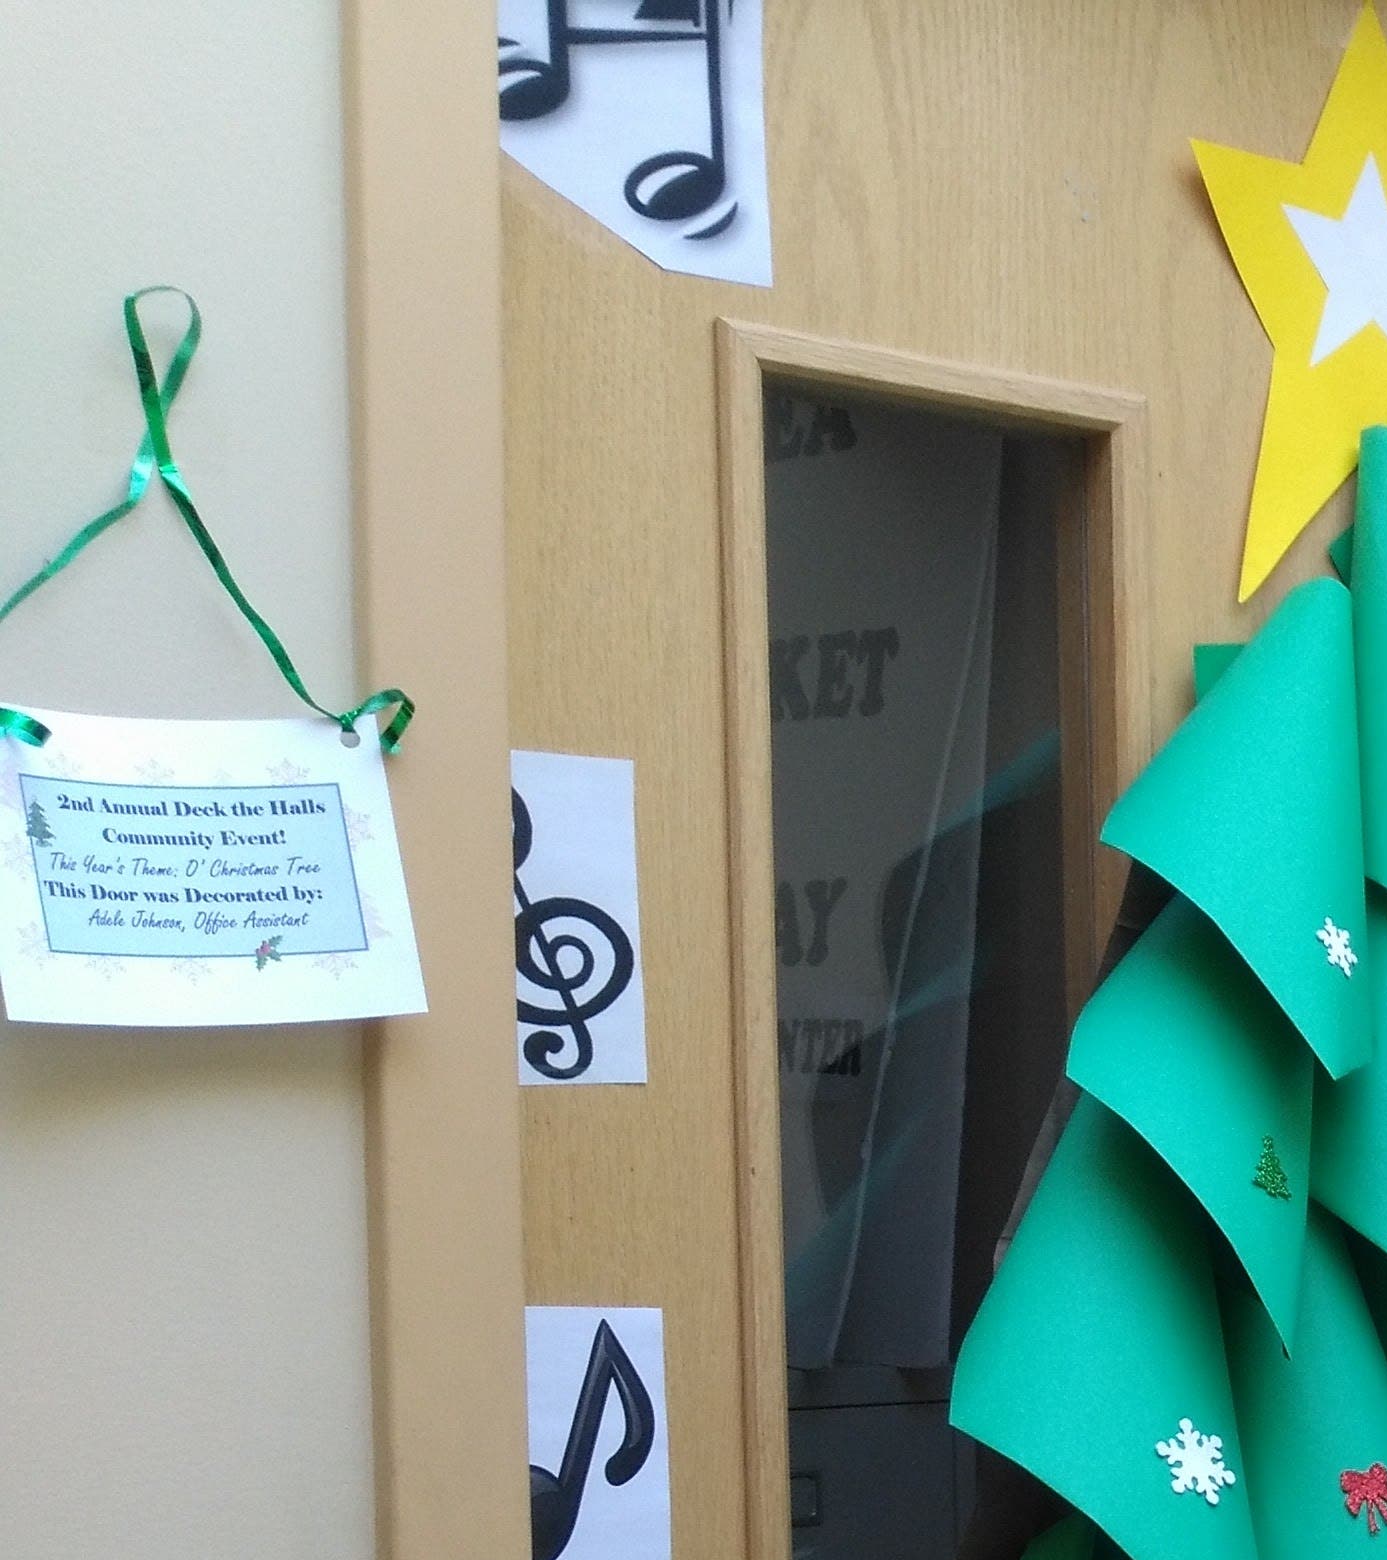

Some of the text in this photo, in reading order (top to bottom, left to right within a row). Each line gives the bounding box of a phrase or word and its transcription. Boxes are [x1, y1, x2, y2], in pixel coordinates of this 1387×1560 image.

[57, 793, 326, 817] 2nd Annual Deck the Halls
[102, 827, 287, 850] Community Event!
[50, 851, 77, 871] This
[83, 854, 126, 875] Year's
[132, 857, 178, 878] Theme:
[209, 858, 279, 877] Christmas
[287, 856, 321, 876] Tree
[43, 880, 323, 905] This Door was Decorated by:
[88, 908, 310, 936] Adele Johnson, Office Assistant
